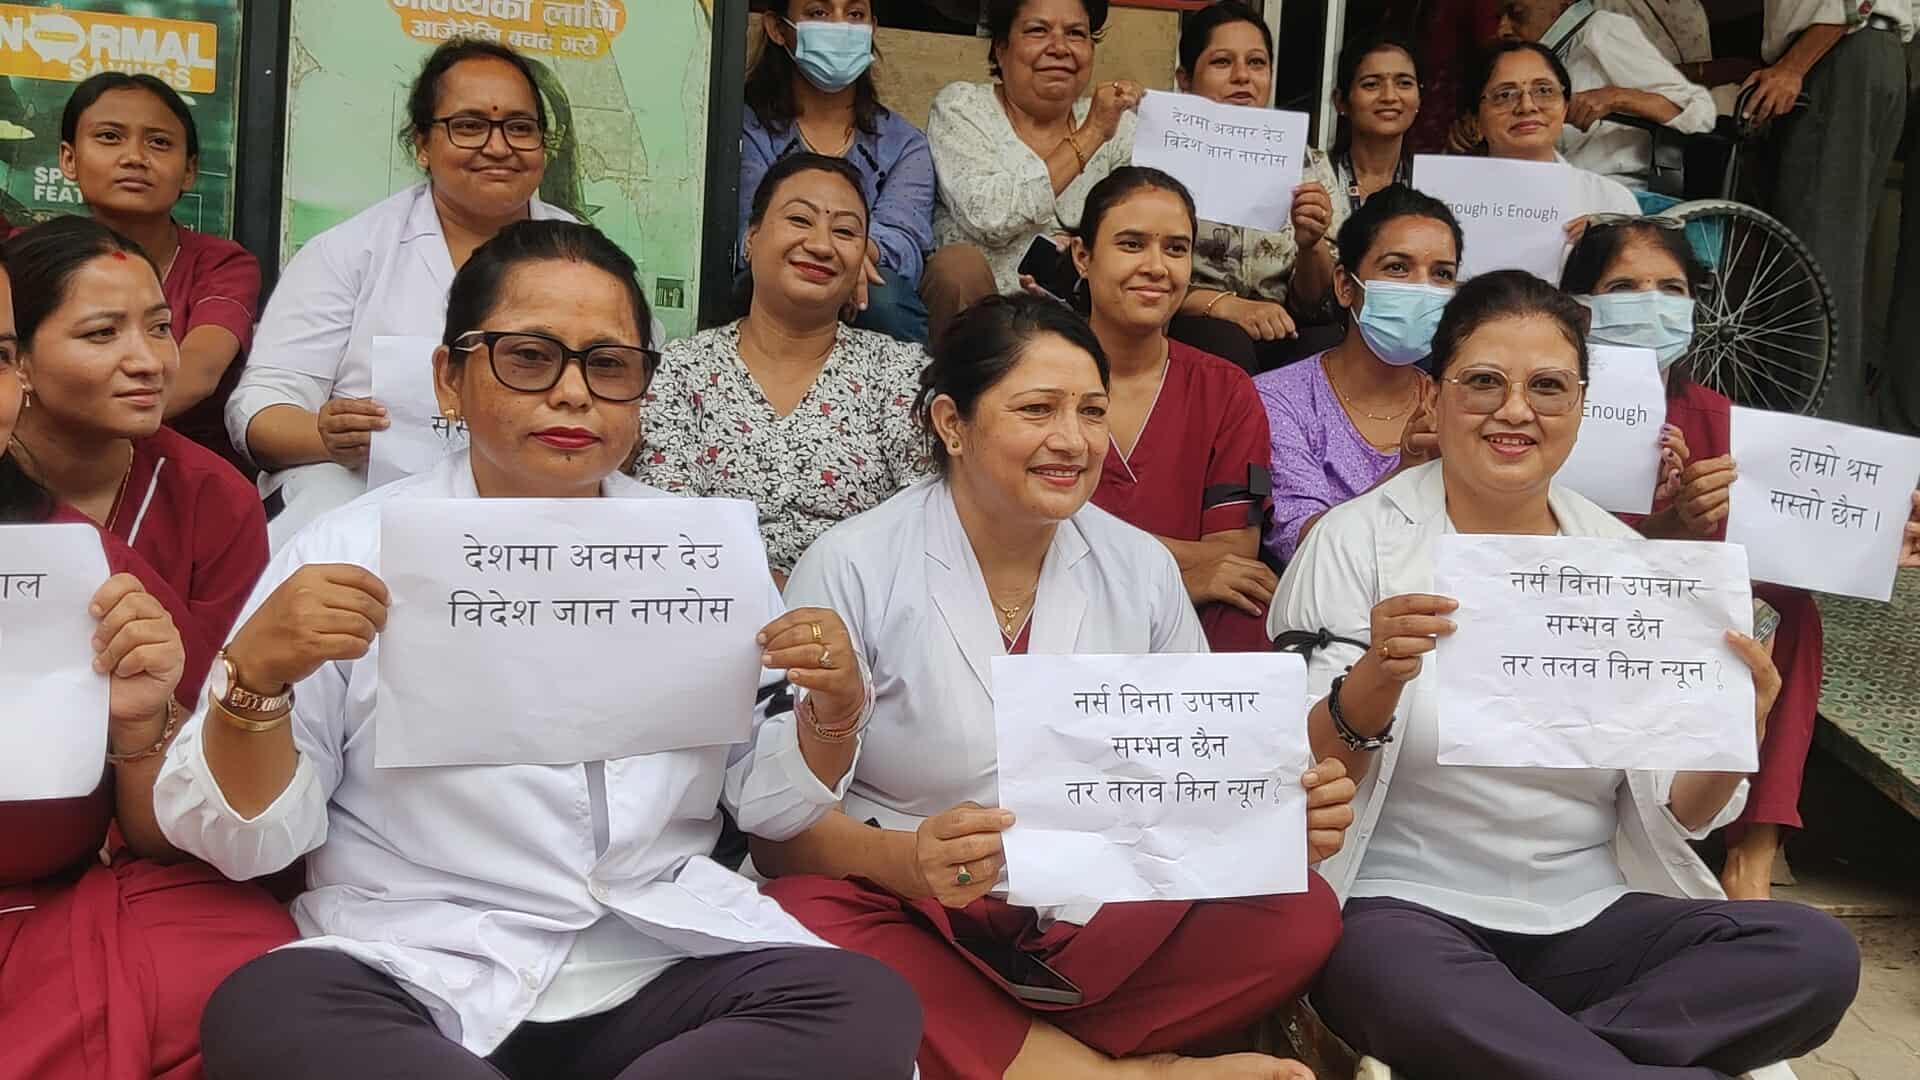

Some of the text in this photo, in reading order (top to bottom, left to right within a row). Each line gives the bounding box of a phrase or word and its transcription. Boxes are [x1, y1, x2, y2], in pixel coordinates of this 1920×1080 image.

[1172, 106, 1209, 131] देशमा
[1164, 130, 1203, 152] विदेश
[1447, 202, 1559, 222] nough is Enough
[1583, 399, 1647, 426] Enough
[1789, 445, 1884, 485] हाम्रो श्रम
[1770, 488, 1825, 520] सस्तो
[1831, 494, 1868, 528] छैन
[463, 533, 723, 572] देशमा अवसर देउ
[1509, 565, 1702, 600] नर्स विना उपचार
[448, 587, 734, 627] विदेश जान नपरोस
[1545, 610, 1664, 640] सम्भव छैन
[1501, 655, 1534, 677] तर
[1540, 657, 1600, 678] तलव
[1606, 651, 1654, 680] किन
[1073, 684, 1260, 714] नर्स विना उपचार
[1111, 727, 1229, 760] सम्भव छैन
[1065, 782, 1099, 805] तर
[1106, 780, 1168, 804] तलव
[1174, 772, 1220, 803] किन
